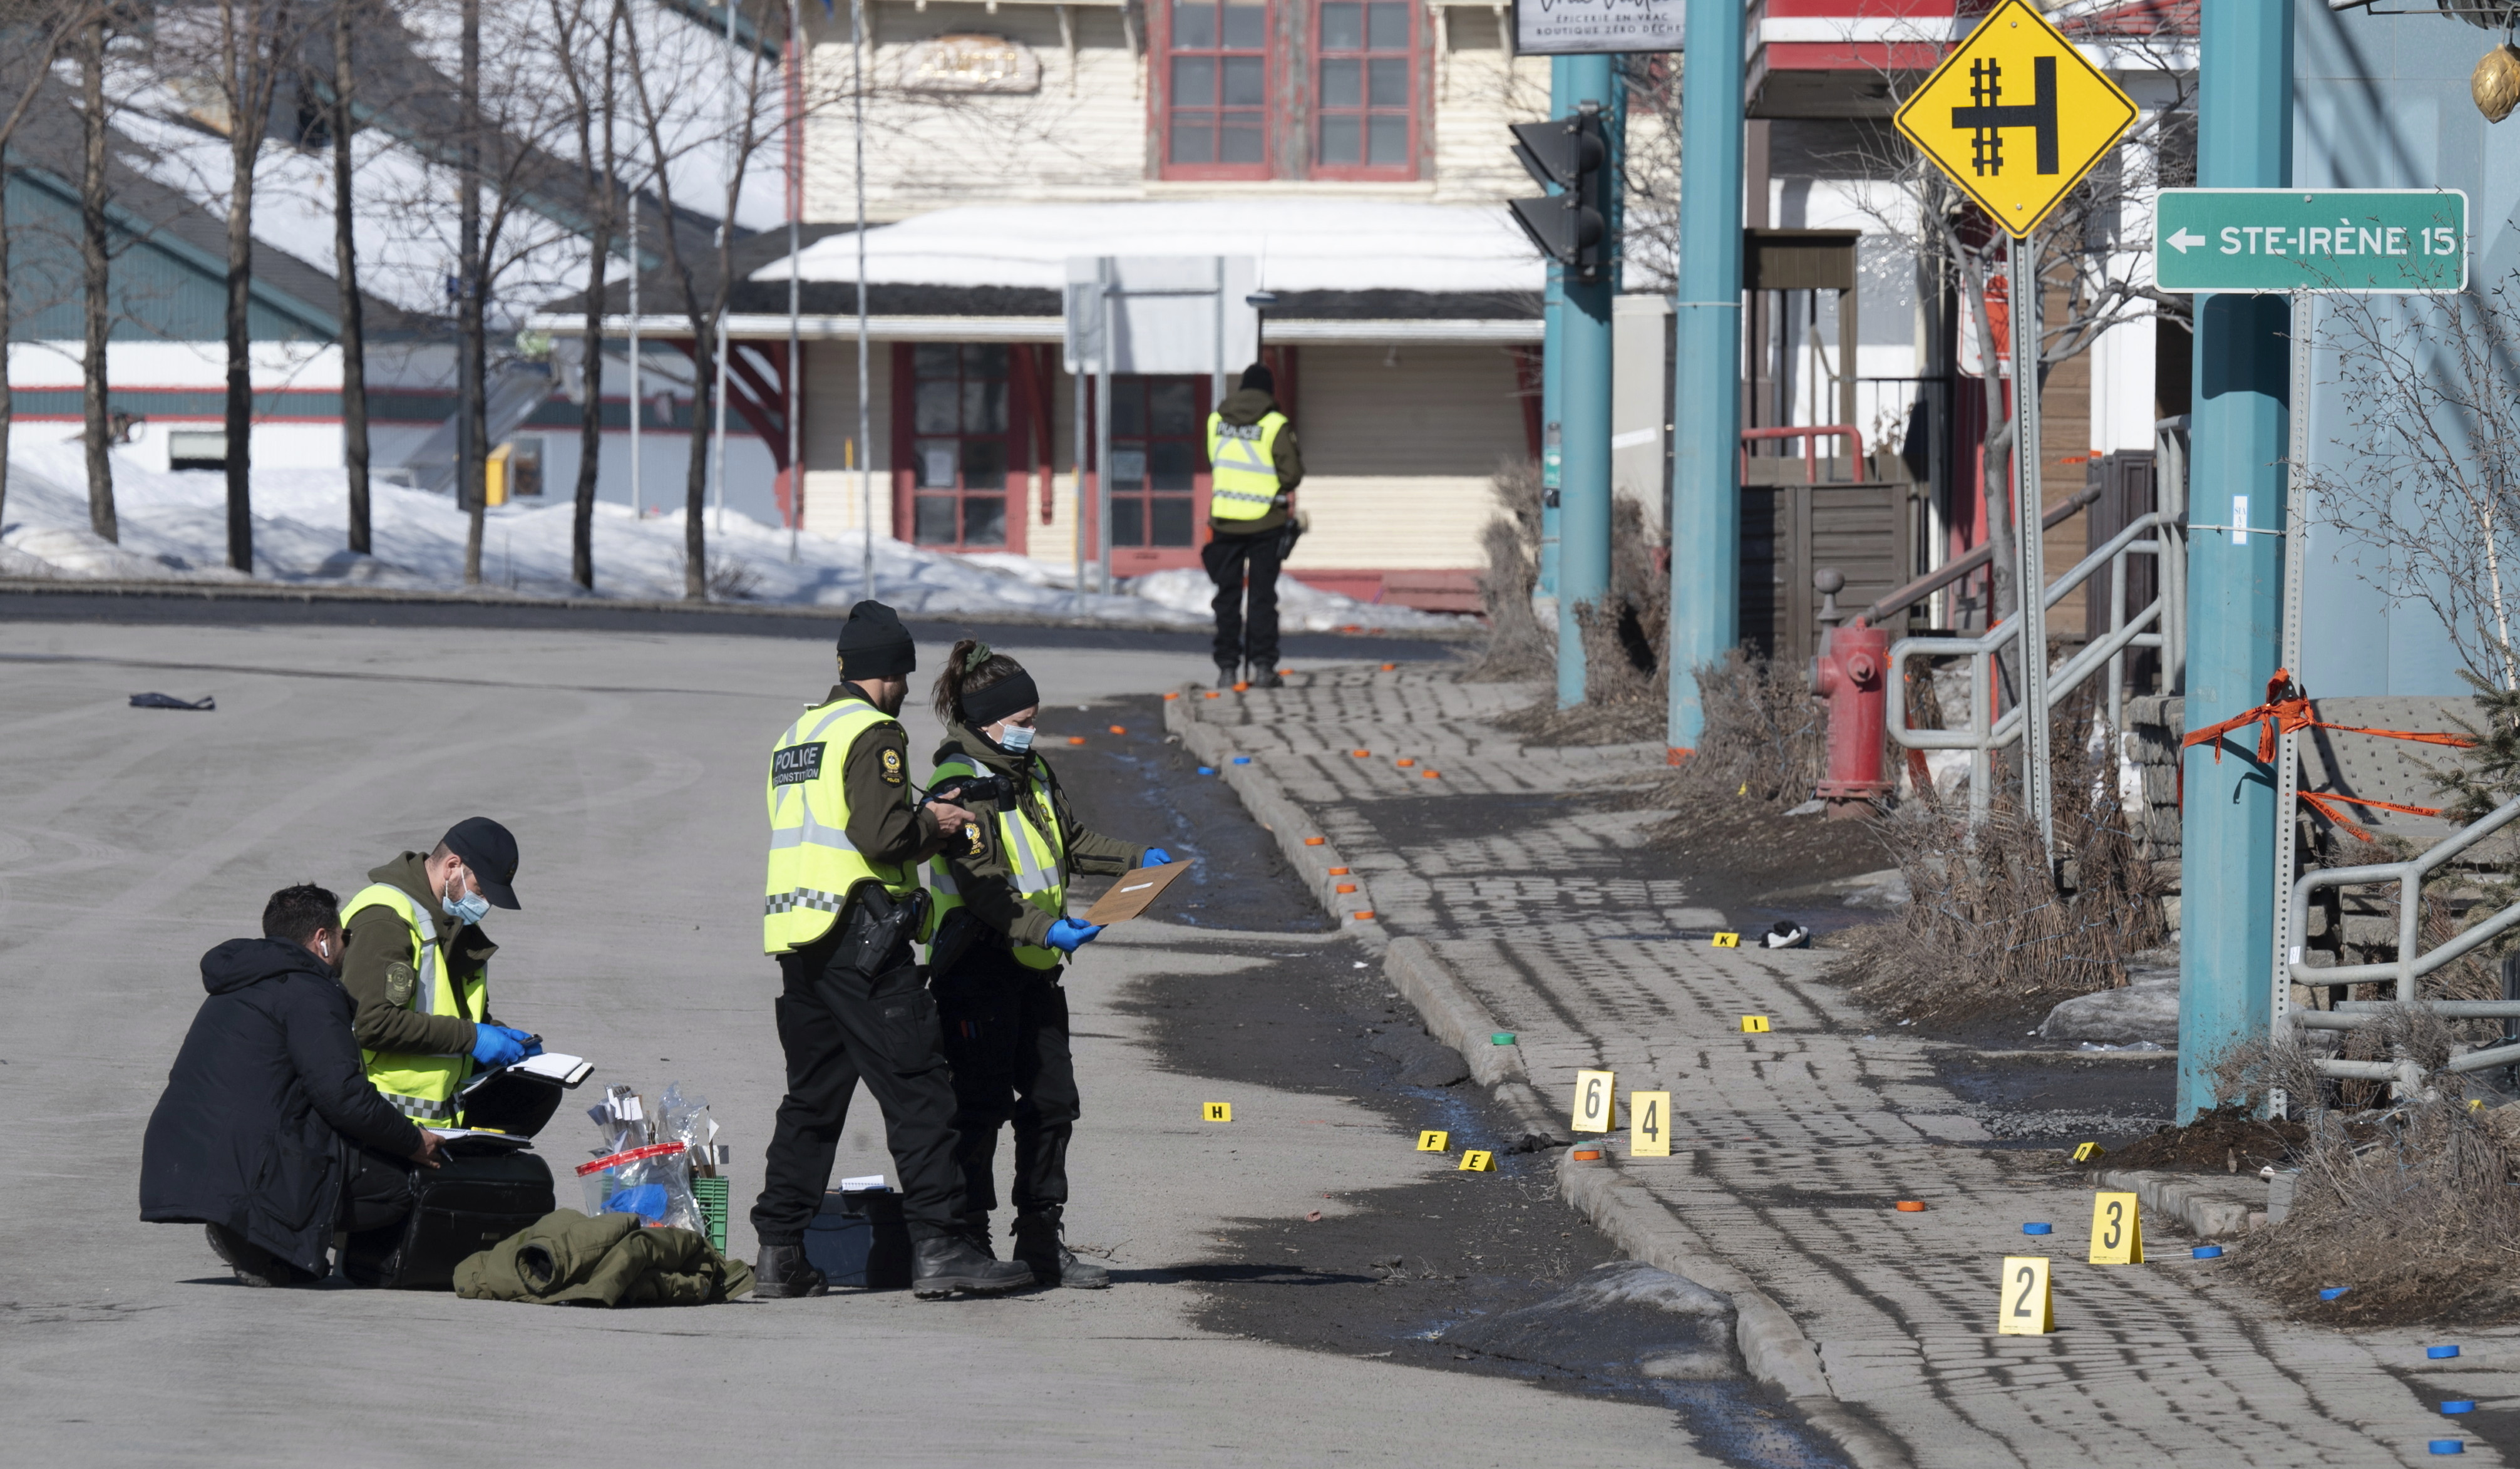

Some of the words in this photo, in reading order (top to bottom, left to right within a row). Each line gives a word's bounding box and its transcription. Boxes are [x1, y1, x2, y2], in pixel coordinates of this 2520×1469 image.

[1617, 14, 1630, 22] EN
[1638, 13, 1668, 21] VRAC
[1536, 26, 1597, 36] BOUTIQUE
[1605, 24, 1635, 34] ZÉRO
[2219, 218, 2407, 255] STE-IRÈNE
[2421, 227, 2456, 255] 15
[775, 746, 818, 772] POLICE
[1719, 936, 1730, 946] K
[1753, 1019, 1759, 1031] I
[1585, 1078, 1601, 1119] 6
[1212, 1106, 1222, 1118] H
[1642, 1100, 1659, 1142] 4
[1426, 1135, 1437, 1148] F
[1468, 1154, 1481, 1168] E
[2104, 1201, 2123, 1249] 3
[2013, 1267, 2035, 1317] 2
